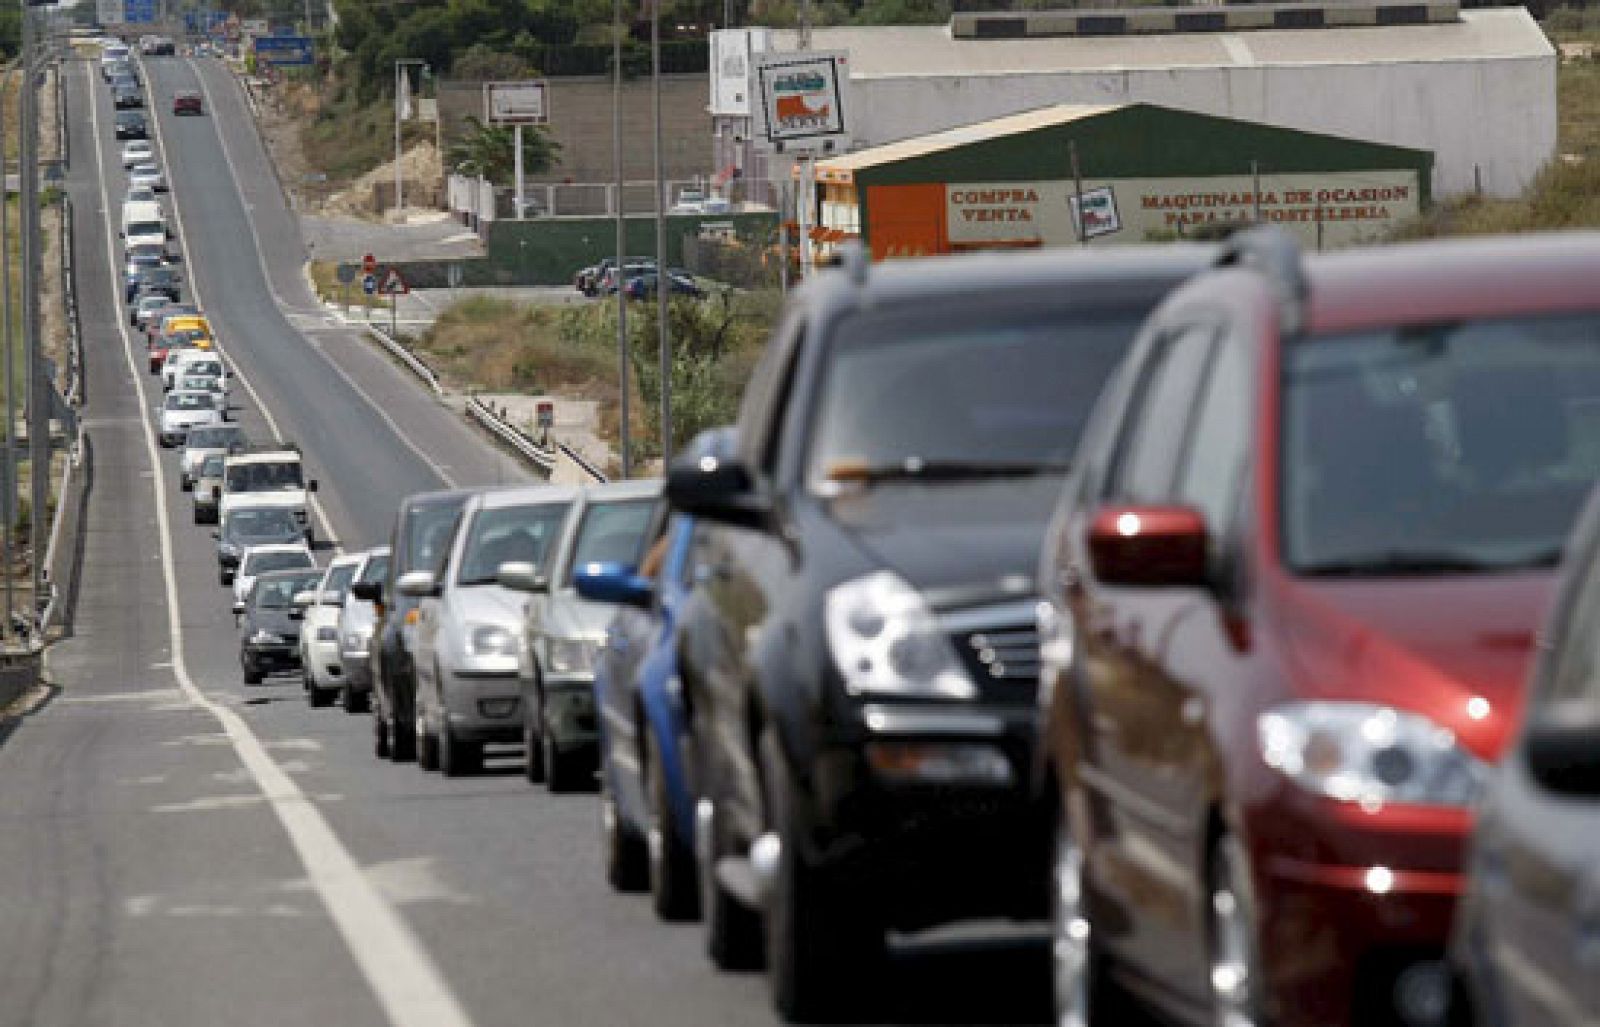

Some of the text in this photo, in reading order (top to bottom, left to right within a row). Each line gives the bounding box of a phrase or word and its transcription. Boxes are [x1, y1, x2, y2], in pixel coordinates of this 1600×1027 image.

[951, 189, 1039, 204] COMPRA
[1142, 191, 1277, 209] MAQUINARIA
[1283, 189, 1312, 204] DE
[961, 208, 1032, 222] VENTA
[1164, 211, 1217, 225] PARA
